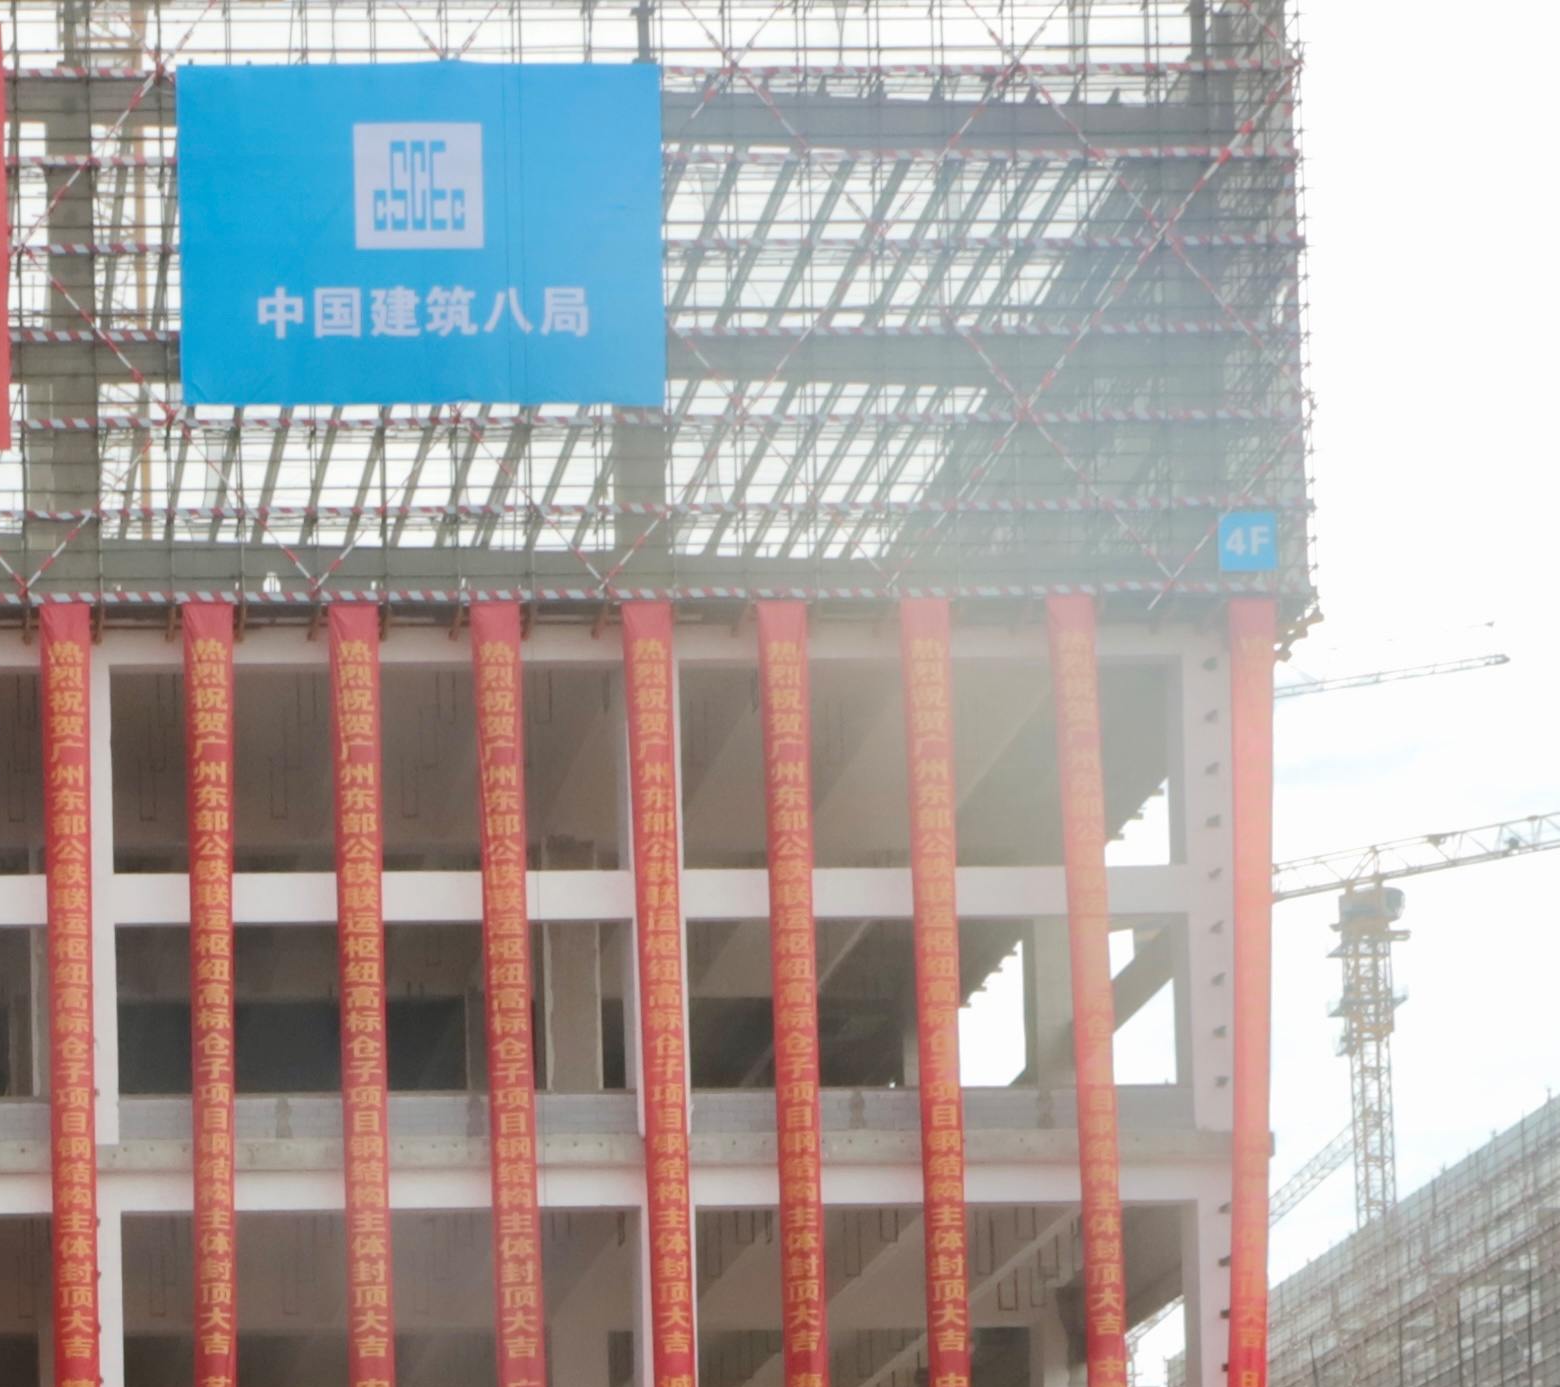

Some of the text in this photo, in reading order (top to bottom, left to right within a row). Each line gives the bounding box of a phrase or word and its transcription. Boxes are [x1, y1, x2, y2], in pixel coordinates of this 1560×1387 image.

[256, 286, 590, 339] 中国建筑八局
[1226, 526, 1269, 556] 4F
